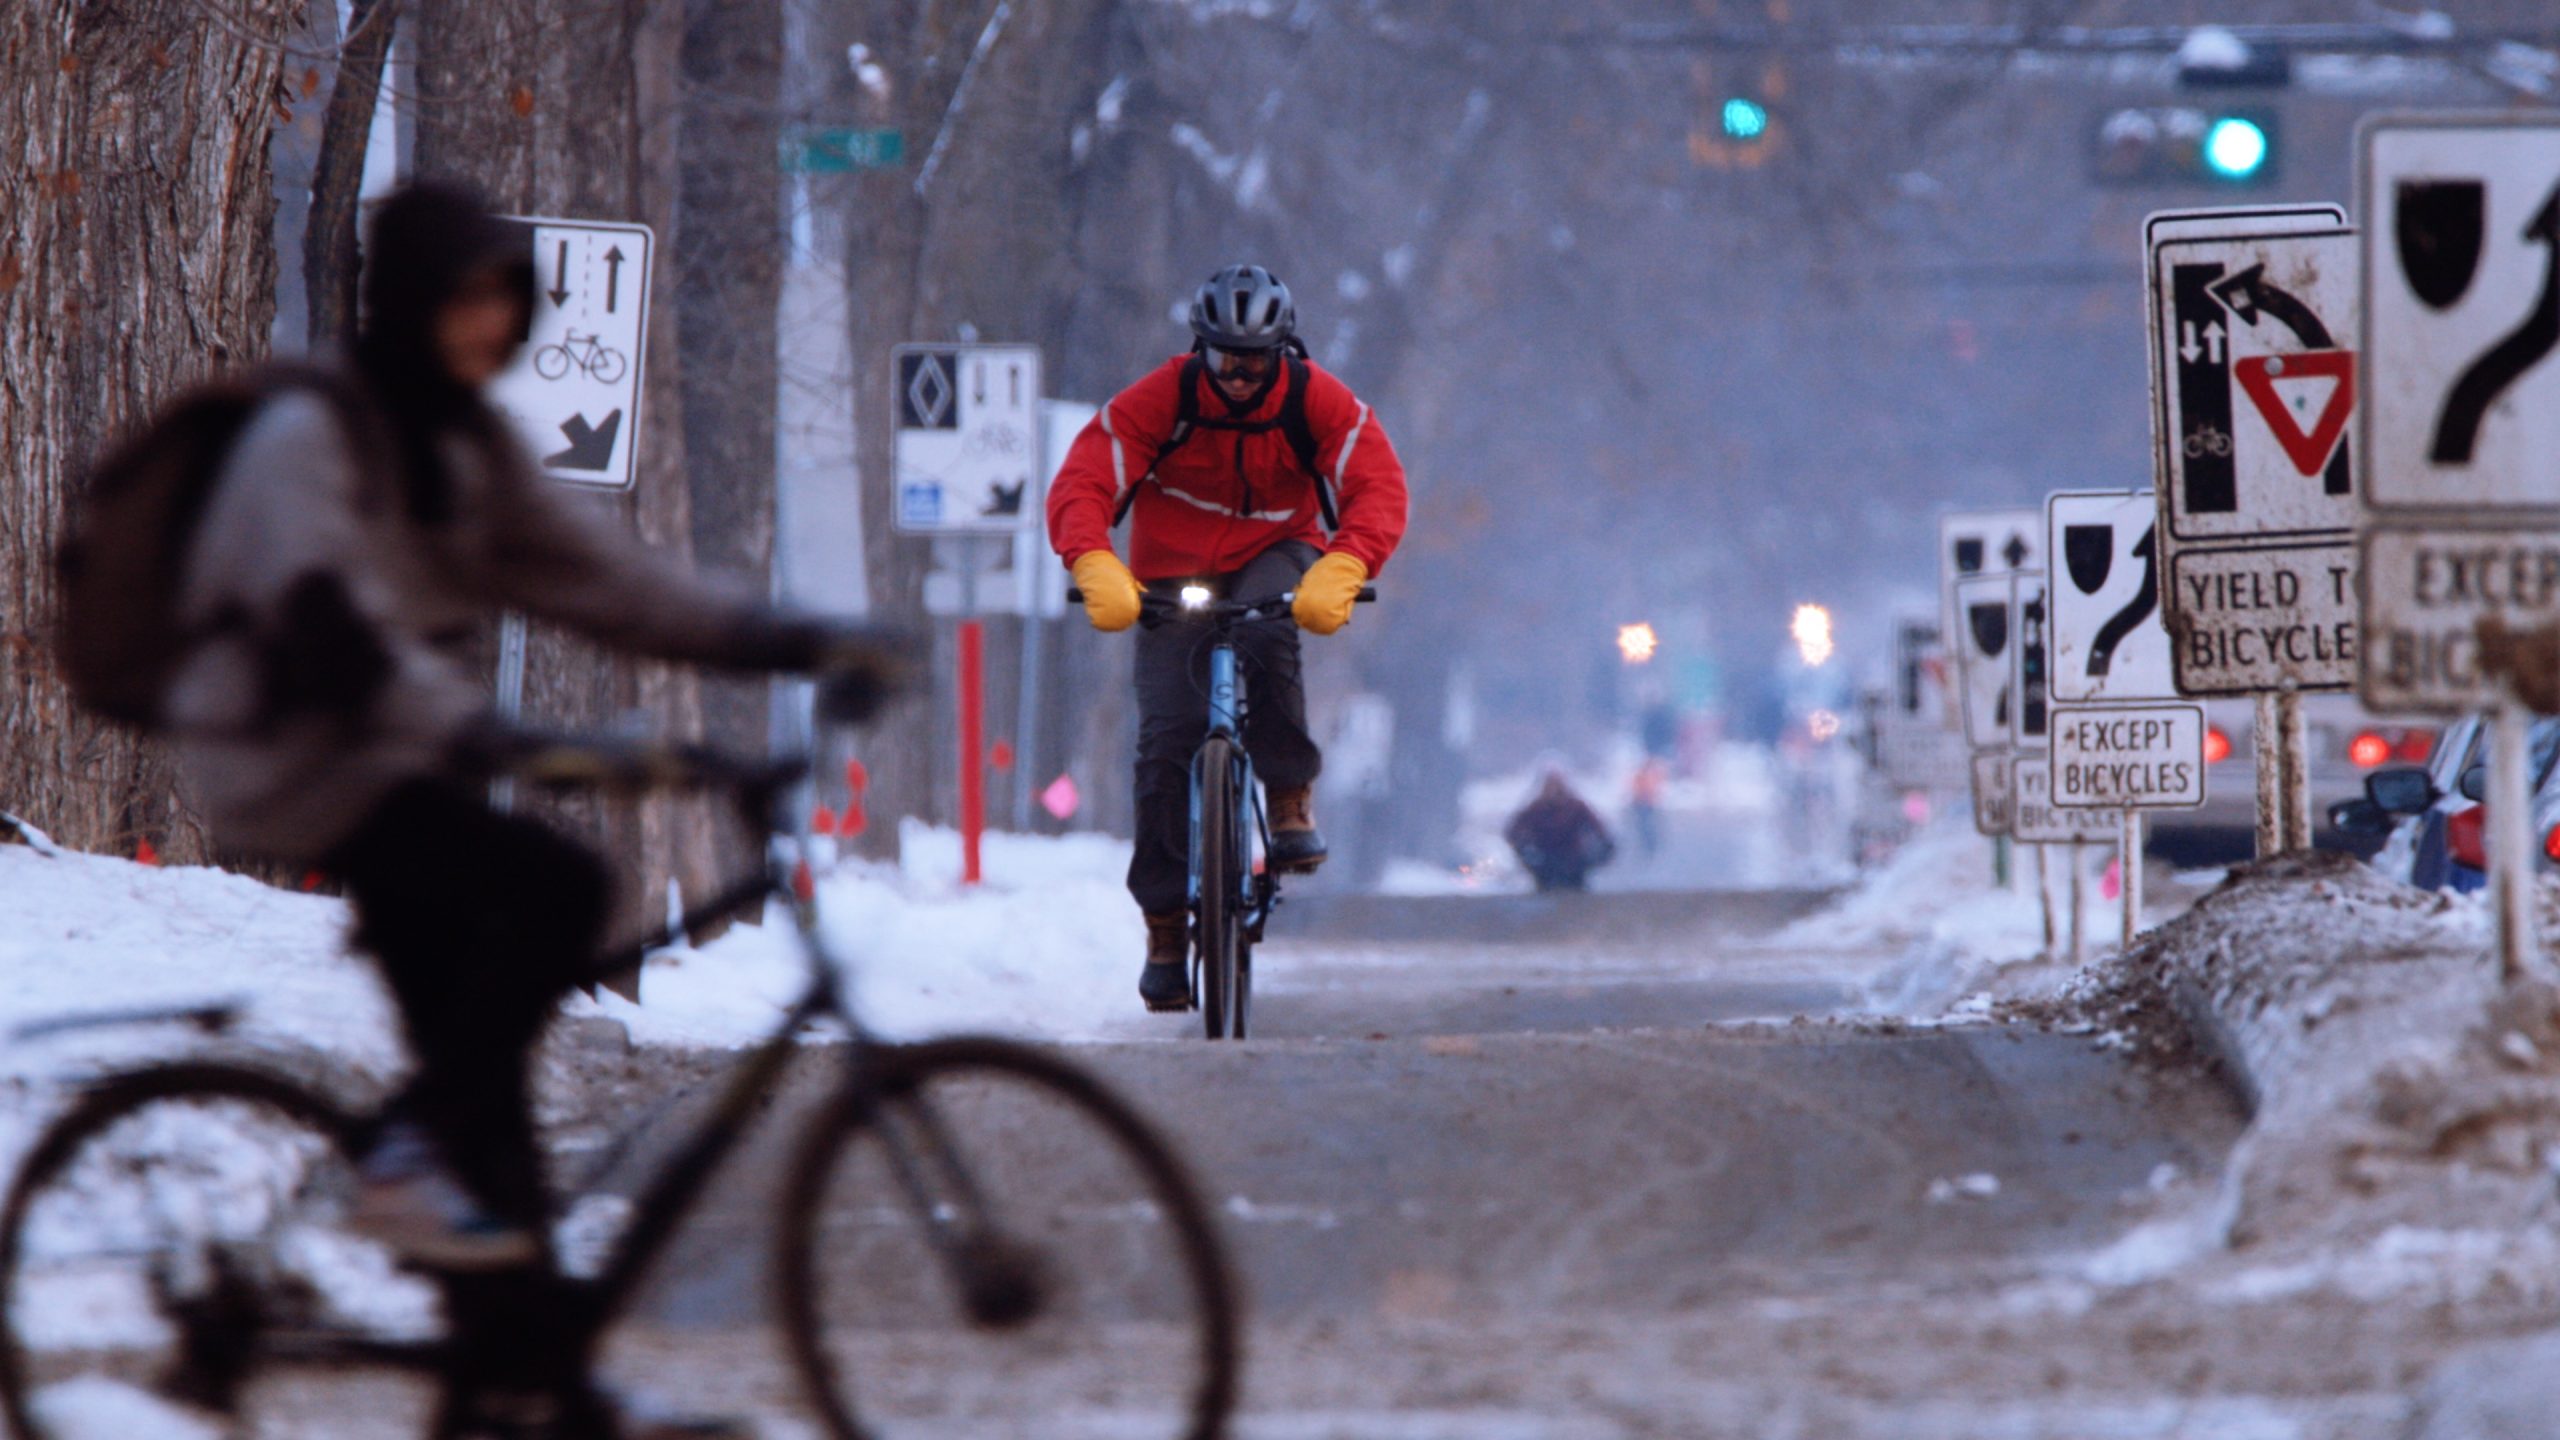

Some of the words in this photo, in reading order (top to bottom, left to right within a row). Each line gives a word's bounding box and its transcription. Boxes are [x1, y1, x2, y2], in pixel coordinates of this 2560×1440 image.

[2188, 569, 2299, 611] YIELD
[2328, 567, 2348, 605] T
[2414, 546, 2560, 608] EXCEP
[2190, 622, 2354, 669] BICYCLE
[2079, 719, 2174, 751] EXCEPT
[2066, 762, 2191, 796] BICYCLES
